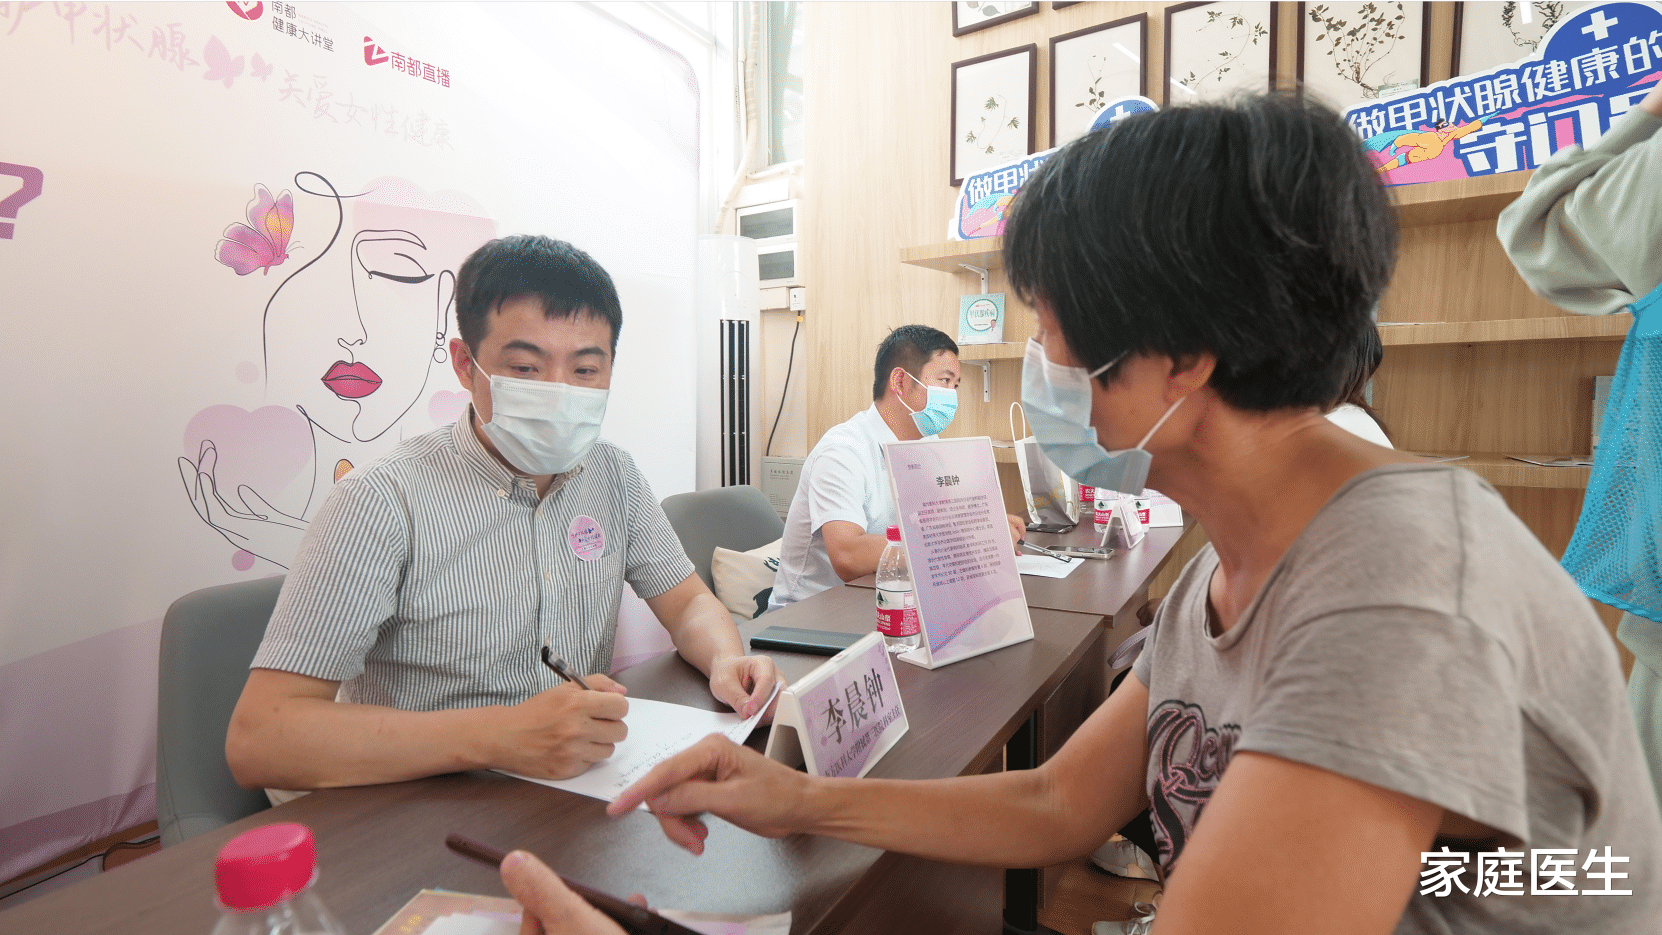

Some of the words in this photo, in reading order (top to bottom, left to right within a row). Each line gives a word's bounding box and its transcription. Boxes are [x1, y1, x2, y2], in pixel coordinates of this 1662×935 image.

[272, 1, 297, 20] 南都
[272, 16, 335, 52] 健康大讲堂
[391, 51, 451, 88] 南都直播
[277, 68, 455, 152] 关爱女性健康
[936, 475, 960, 487] 李晨钟
[820, 668, 884, 744] 李晨钟
